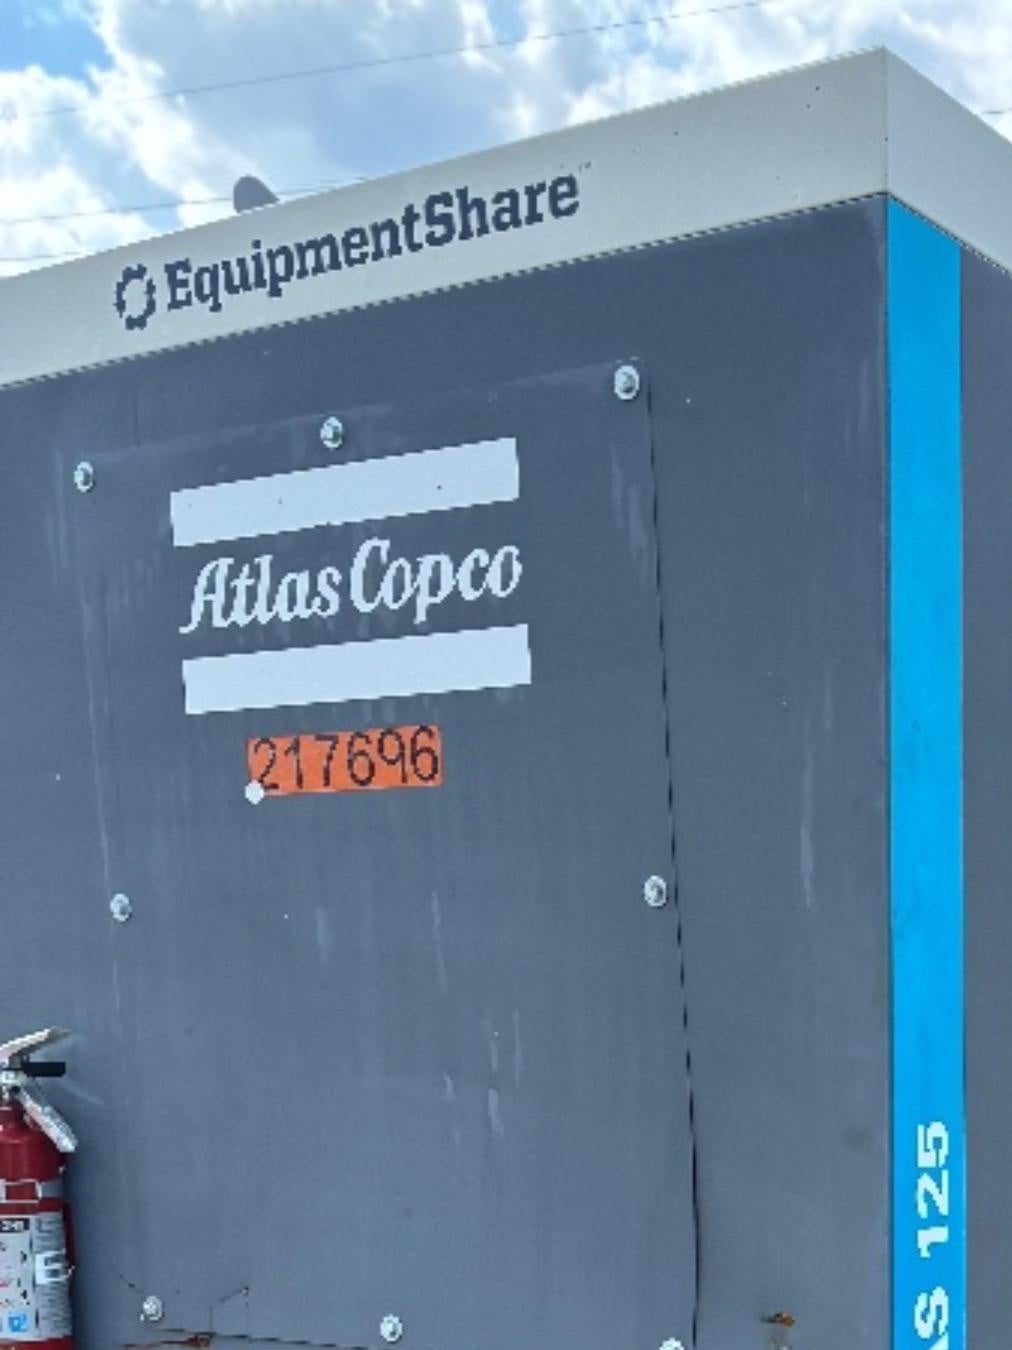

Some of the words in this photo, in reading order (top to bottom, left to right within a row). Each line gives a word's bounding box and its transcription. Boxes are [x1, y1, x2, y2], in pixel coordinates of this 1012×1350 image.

[164, 173, 580, 312] EquipmentShare
[179, 554, 342, 633] Atlas
[350, 538, 522, 624] Copco
[253, 725, 440, 790] 217696
[917, 1121, 949, 1259] 125
